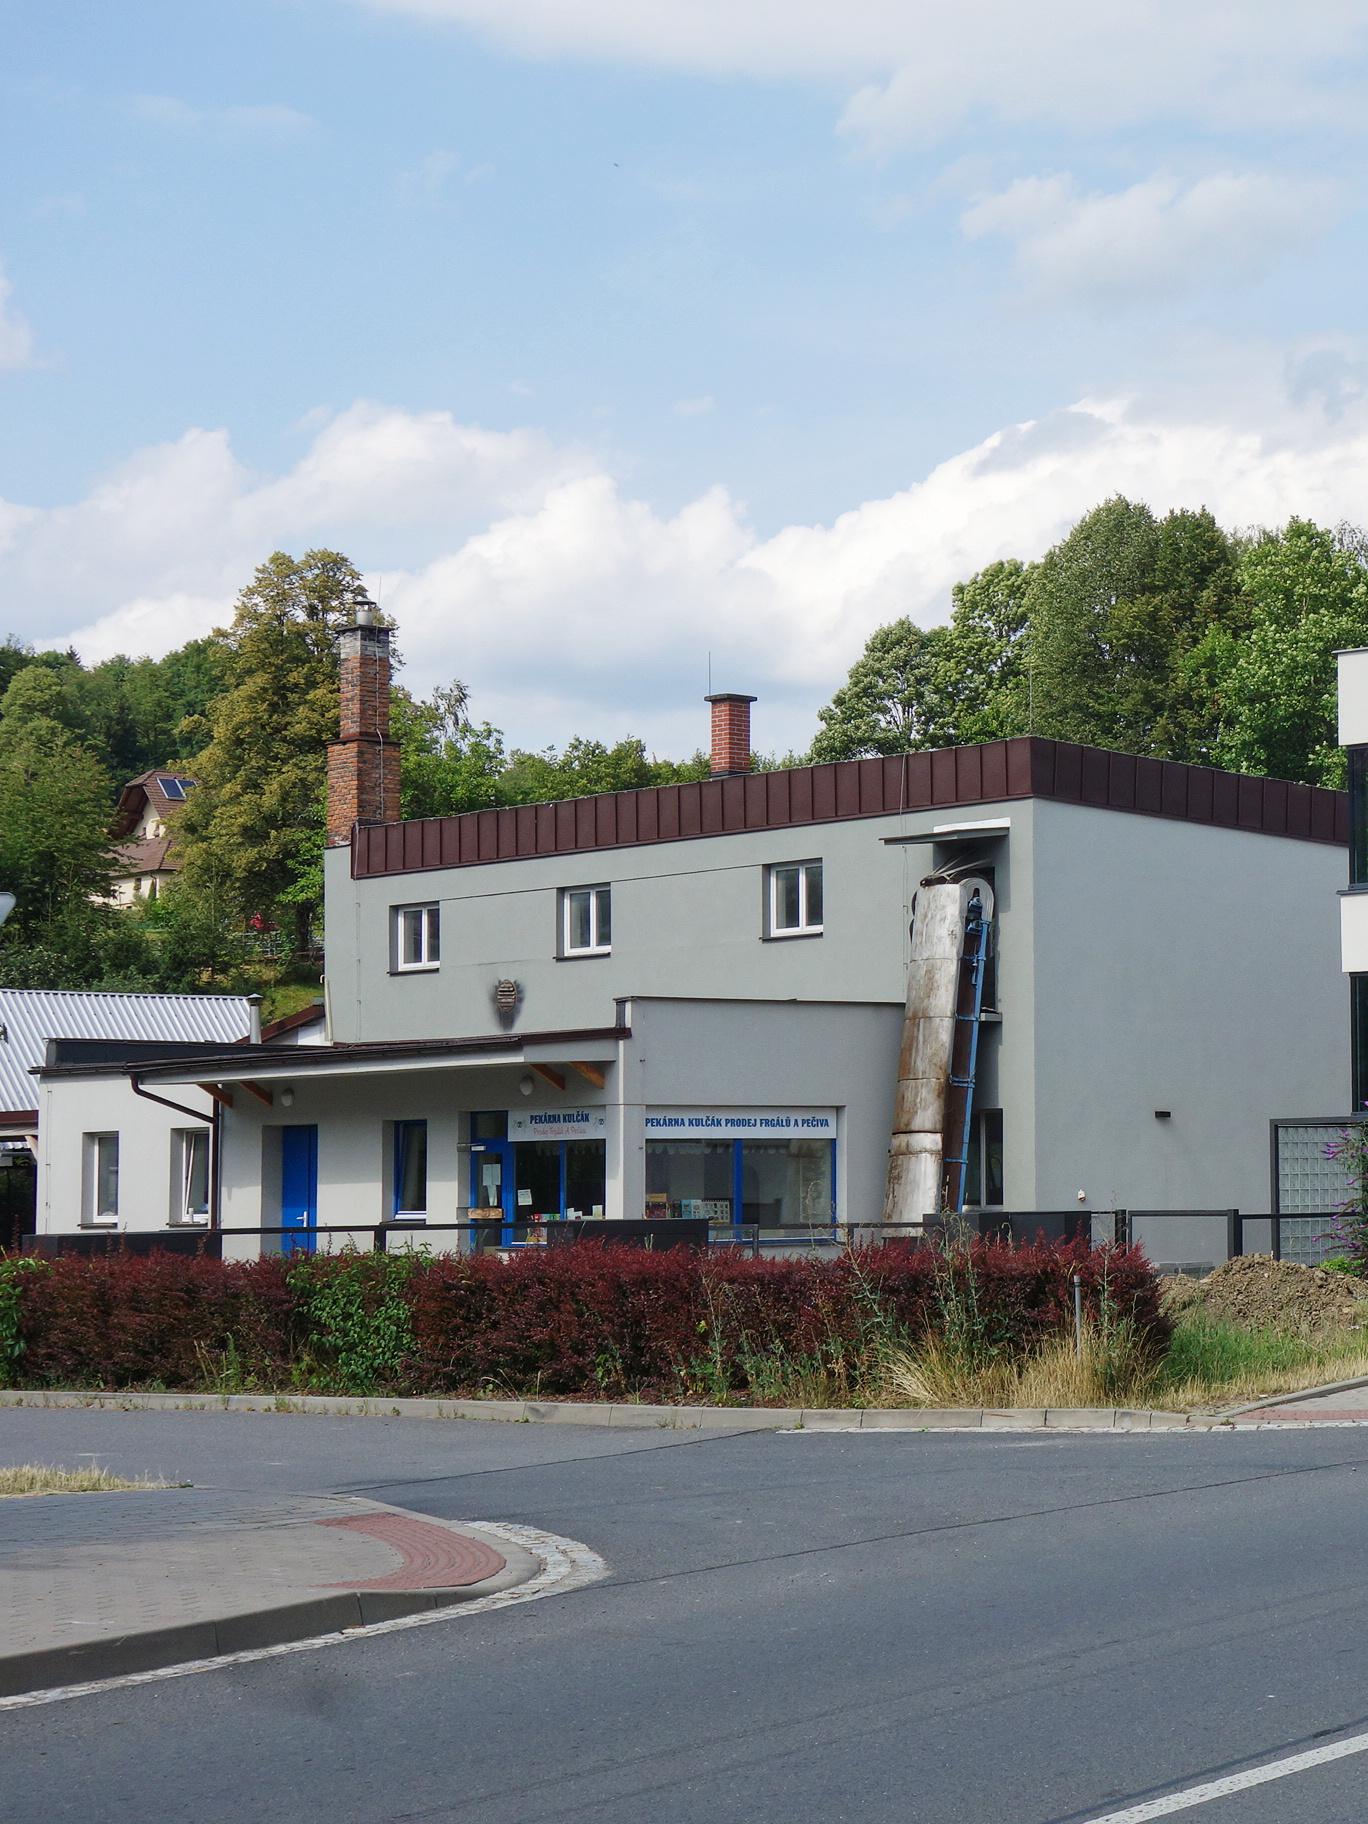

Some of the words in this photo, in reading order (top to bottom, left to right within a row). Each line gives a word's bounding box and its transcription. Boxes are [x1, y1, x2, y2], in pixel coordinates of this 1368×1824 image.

[529, 1112, 560, 1124] PEKÁRNA
[562, 1110, 590, 1123] KULČÁK
[645, 1116, 686, 1128] PEKÁRNA
[688, 1115, 722, 1128] KULČÁK
[725, 1118, 757, 1128] PRODEJ
[760, 1116, 791, 1128] FRGÁLŮ
[793, 1118, 799, 1127] A
[801, 1116, 830, 1128] PEČIVA
